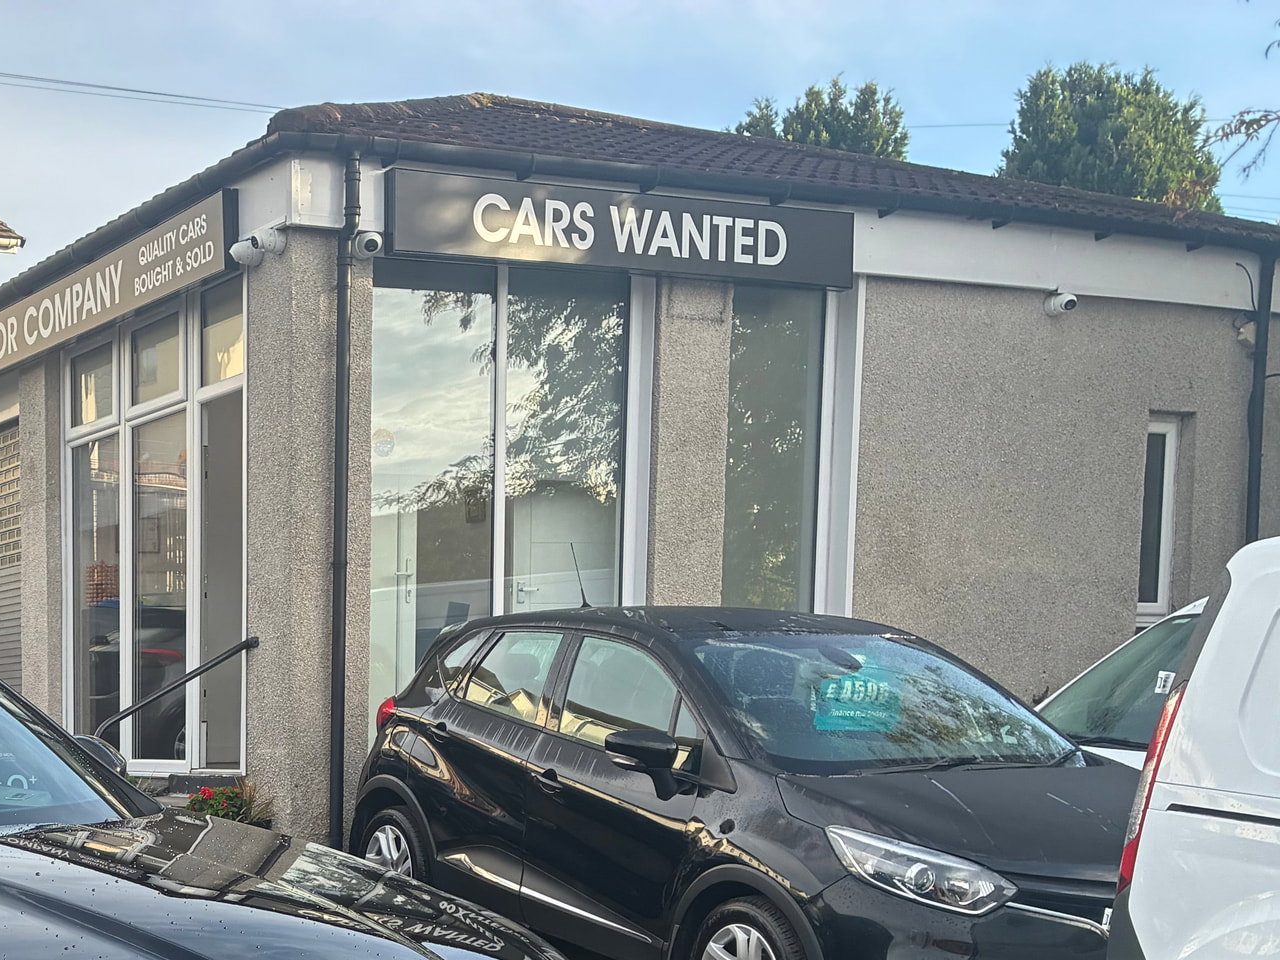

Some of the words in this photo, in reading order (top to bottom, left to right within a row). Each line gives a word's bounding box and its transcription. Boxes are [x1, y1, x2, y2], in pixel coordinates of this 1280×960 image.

[138, 230, 177, 266] QUALITY
[179, 214, 207, 246] CARS
[473, 193, 595, 251] CARS
[610, 205, 788, 266] WANTED
[134, 268, 173, 296] BOUGHT
[175, 260, 184, 276] &
[186, 241, 214, 269] SOLD
[23, 259, 123, 346] COMPANY
